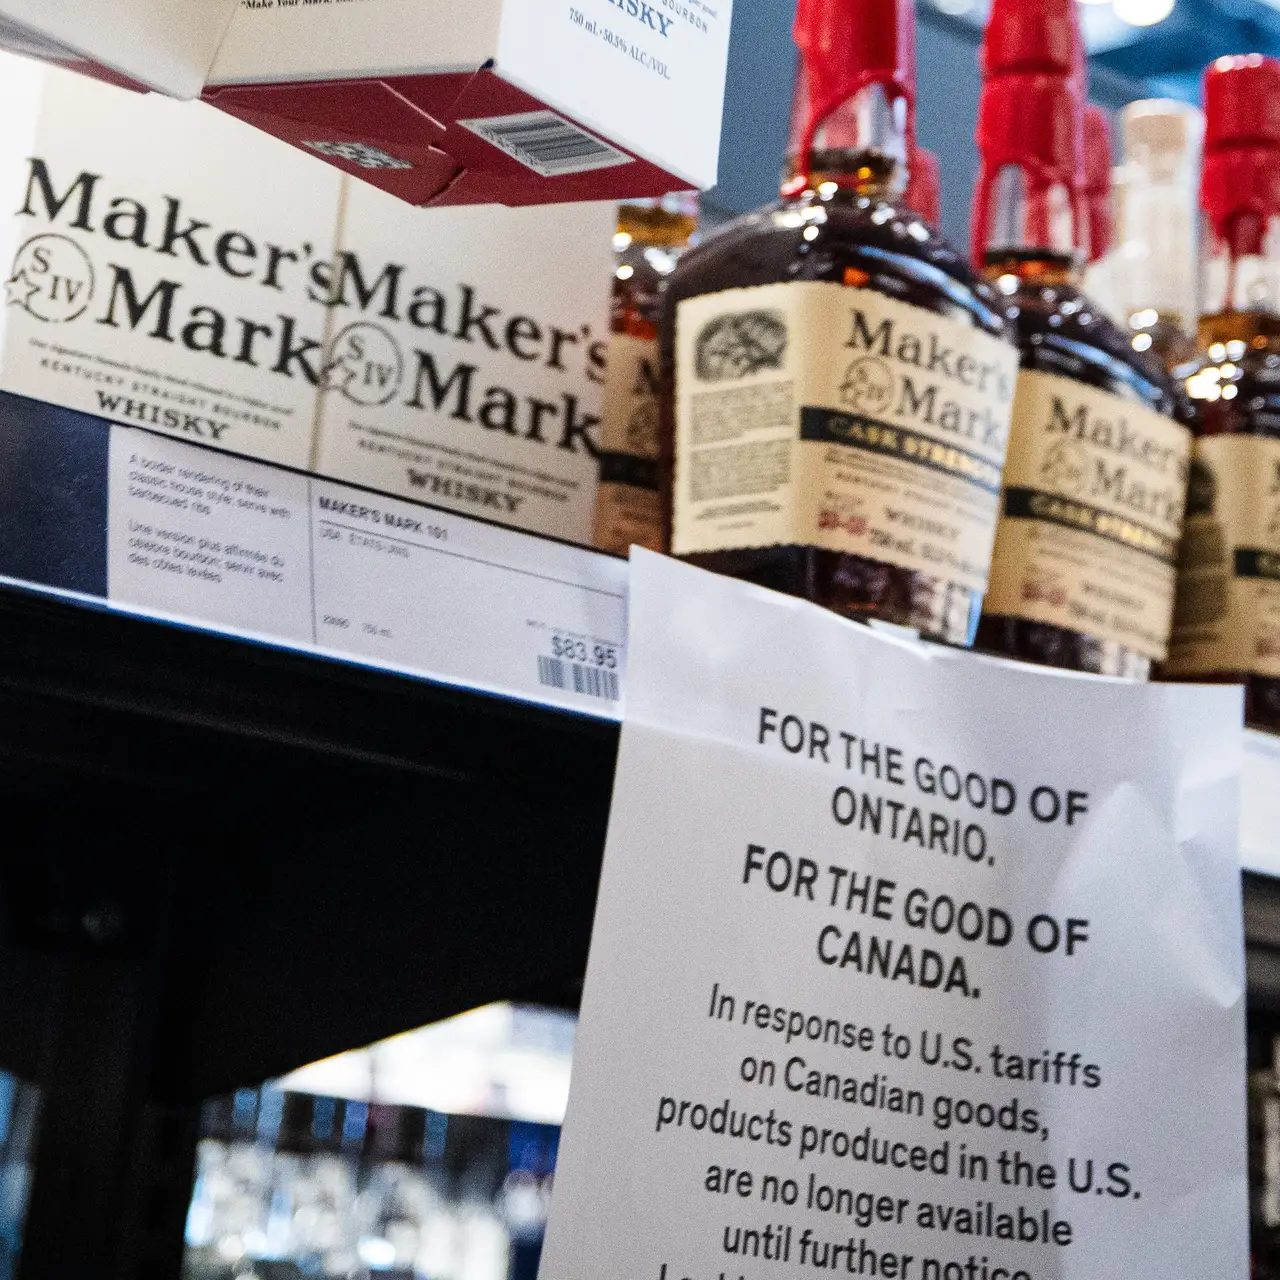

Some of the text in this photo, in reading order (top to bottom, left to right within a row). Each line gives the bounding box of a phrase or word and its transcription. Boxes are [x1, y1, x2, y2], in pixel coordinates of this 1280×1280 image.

[569, 6, 584, 26] 750
[602, 27, 627, 53] 50.5%
[16, 157, 338, 308] Maker's
[95, 262, 324, 388] Mark
[333, 250, 607, 387] Maker's
[96, 390, 228, 440] WHISKY
[405, 348, 604, 457] Mark
[898, 379, 1006, 452] Mark
[318, 495, 380, 523] MAKER'S
[405, 468, 527, 514] WHISKY
[552, 635, 618, 669] $83.95
[757, 707, 1089, 825] FOR THE GOOD OF
[831, 785, 996, 867] ONTARIO.
[742, 843, 1090, 956] FOR THE GOOD OF
[817, 924, 982, 999] CANADA.
[708, 982, 1102, 1089] In response to U.S. tariffs
[739, 1054, 1050, 1141] on Canadian goods,
[655, 1091, 1143, 1200] products produced in the U.S.
[704, 1162, 1073, 1247] are no longer available
[722, 1224, 791, 1263] until
[799, 1228, 913, 1280] further
